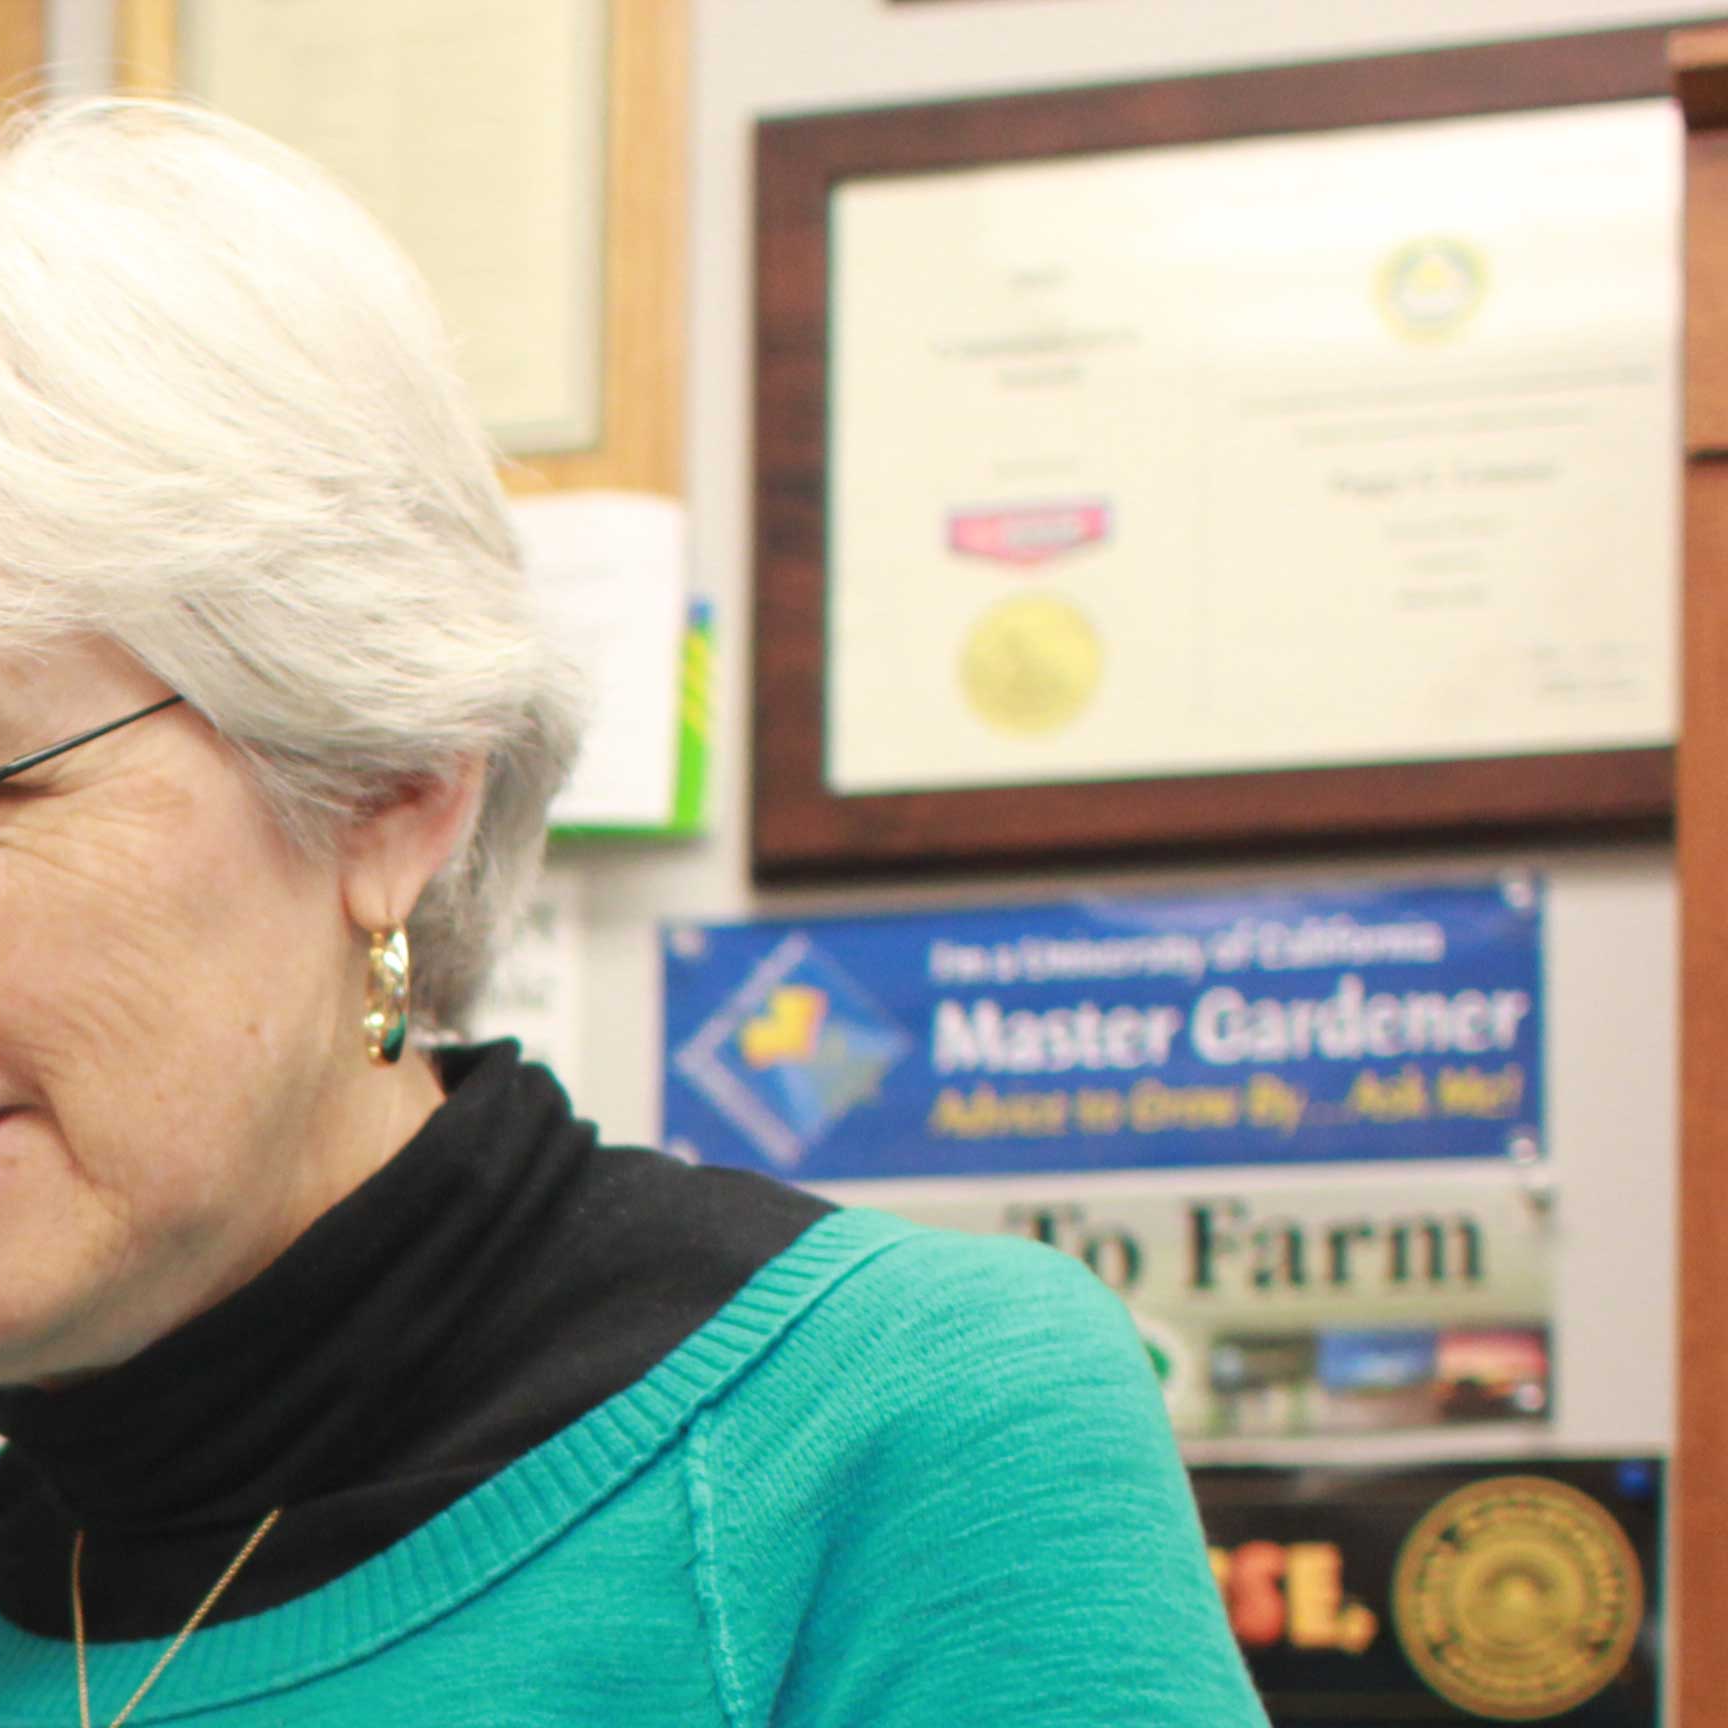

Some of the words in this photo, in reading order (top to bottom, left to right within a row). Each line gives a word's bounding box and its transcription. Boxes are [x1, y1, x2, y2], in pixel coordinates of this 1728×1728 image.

[934, 999, 1181, 1074] Master
[1190, 974, 1530, 1065] Gardener
[1182, 1202, 1484, 1292] Farm
